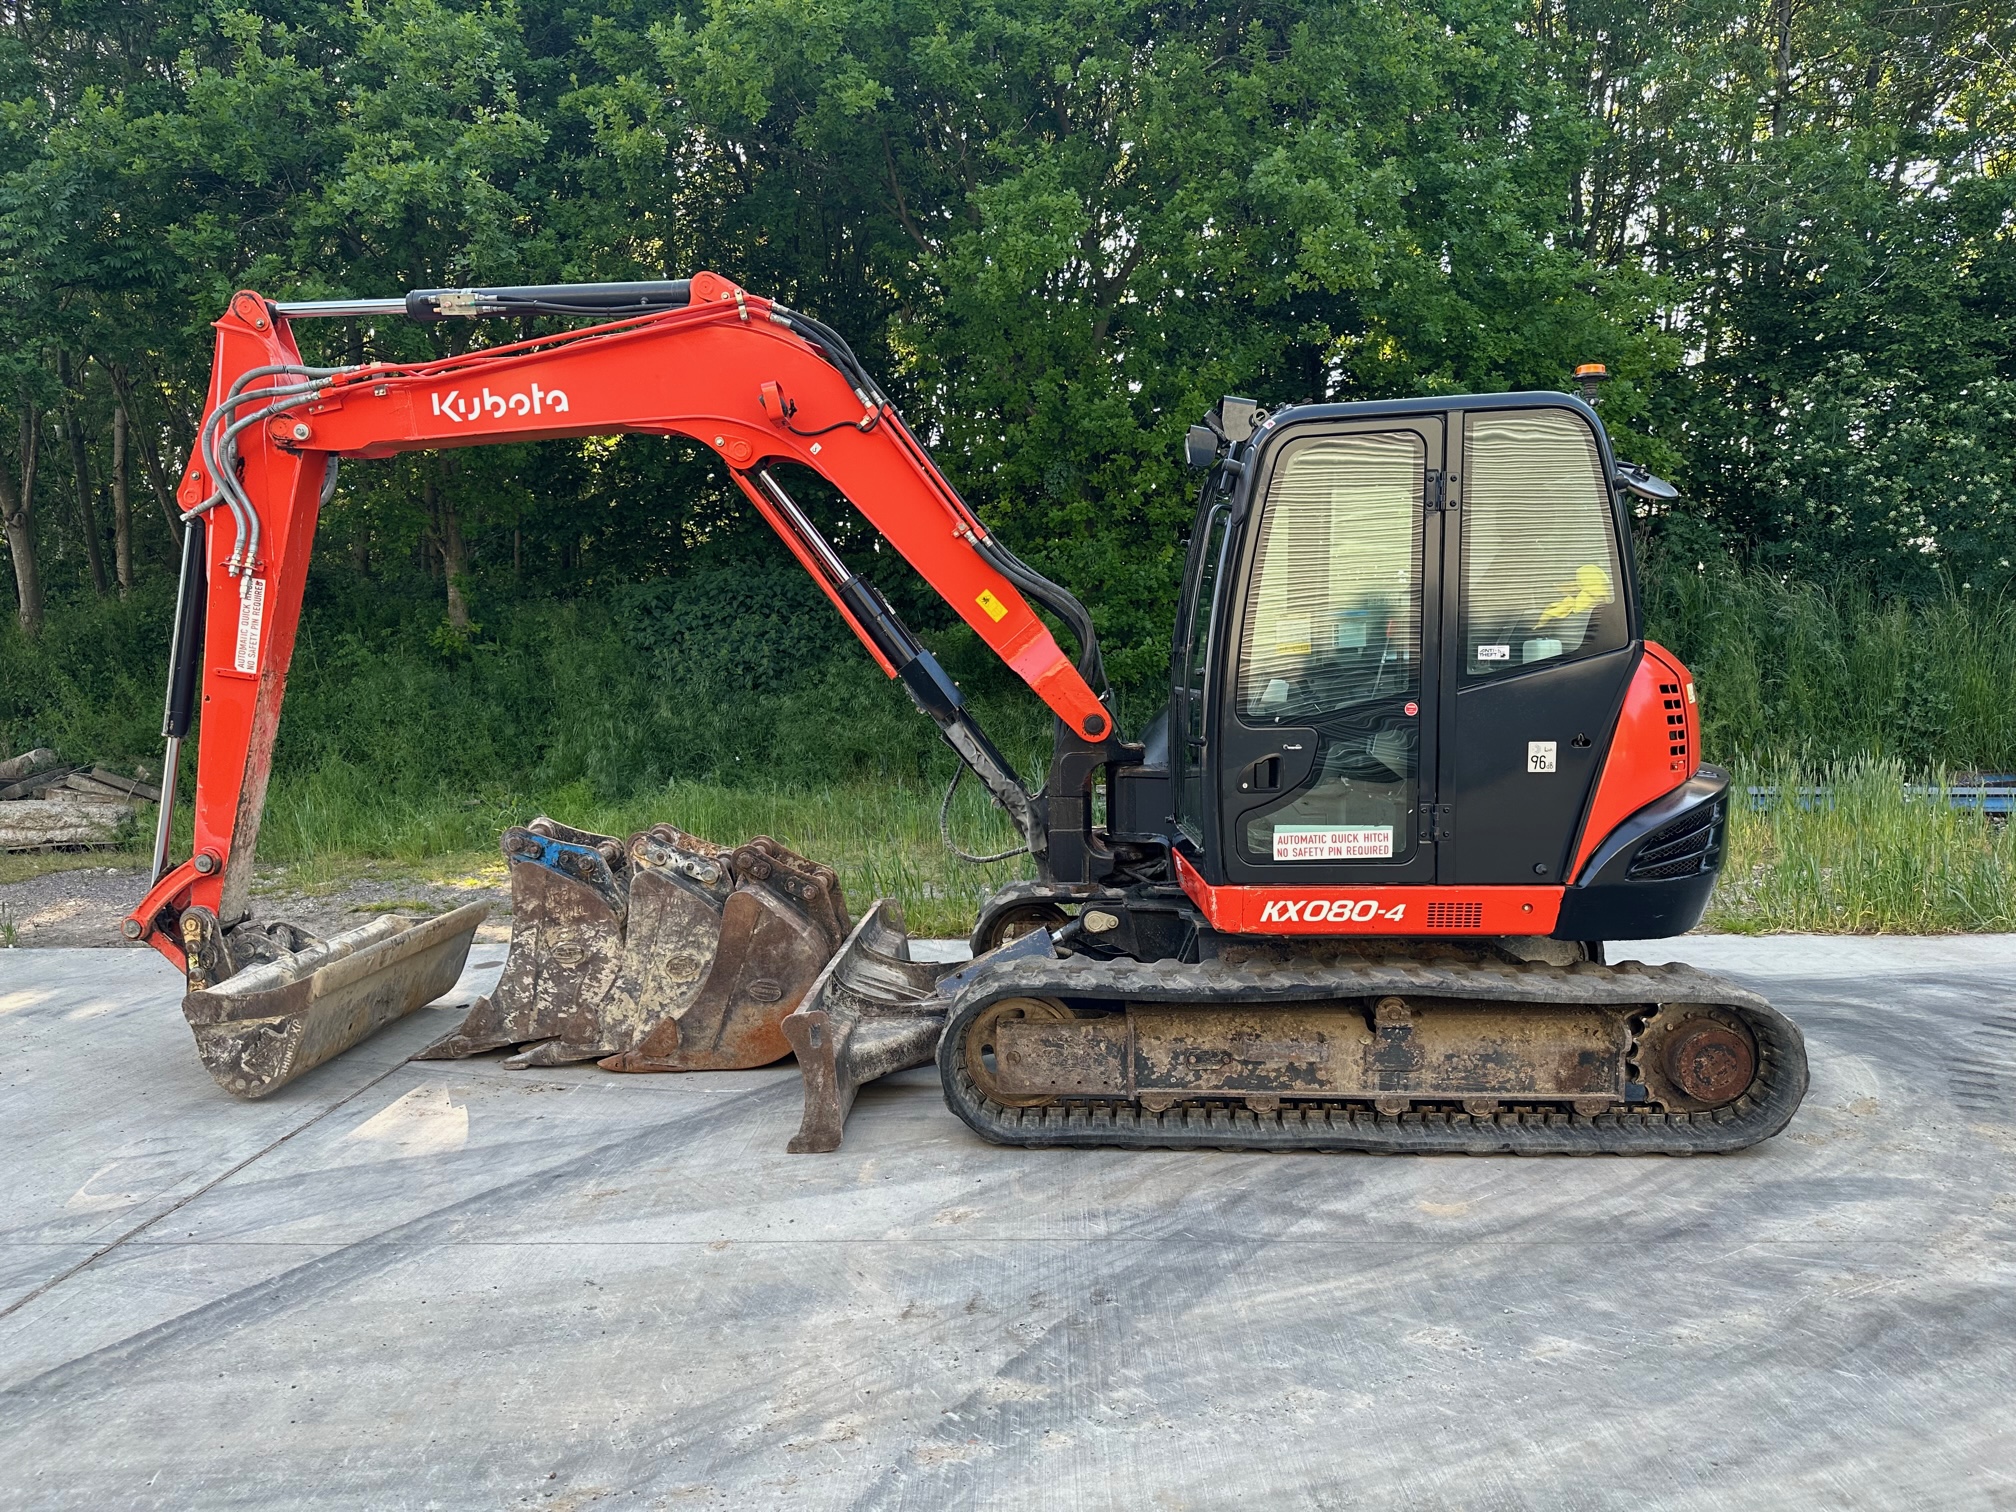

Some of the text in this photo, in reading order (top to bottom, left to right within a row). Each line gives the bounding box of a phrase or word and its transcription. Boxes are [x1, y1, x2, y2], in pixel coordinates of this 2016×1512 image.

[431, 383, 569, 422] Kubota
[241, 604, 251, 626] QUICK
[251, 618, 259, 630] PIN
[237, 629, 248, 668] AUTOMATIC
[248, 632, 259, 658] SAFETY
[246, 660, 256, 671] NO
[1530, 755, 1546, 770] 96
[1277, 832, 1389, 845] AUTOMATIC QUICK HITCH
[1277, 845, 1389, 857] NO SAFETY PIN REQUIRED
[1259, 900, 1407, 922] KX080-4
